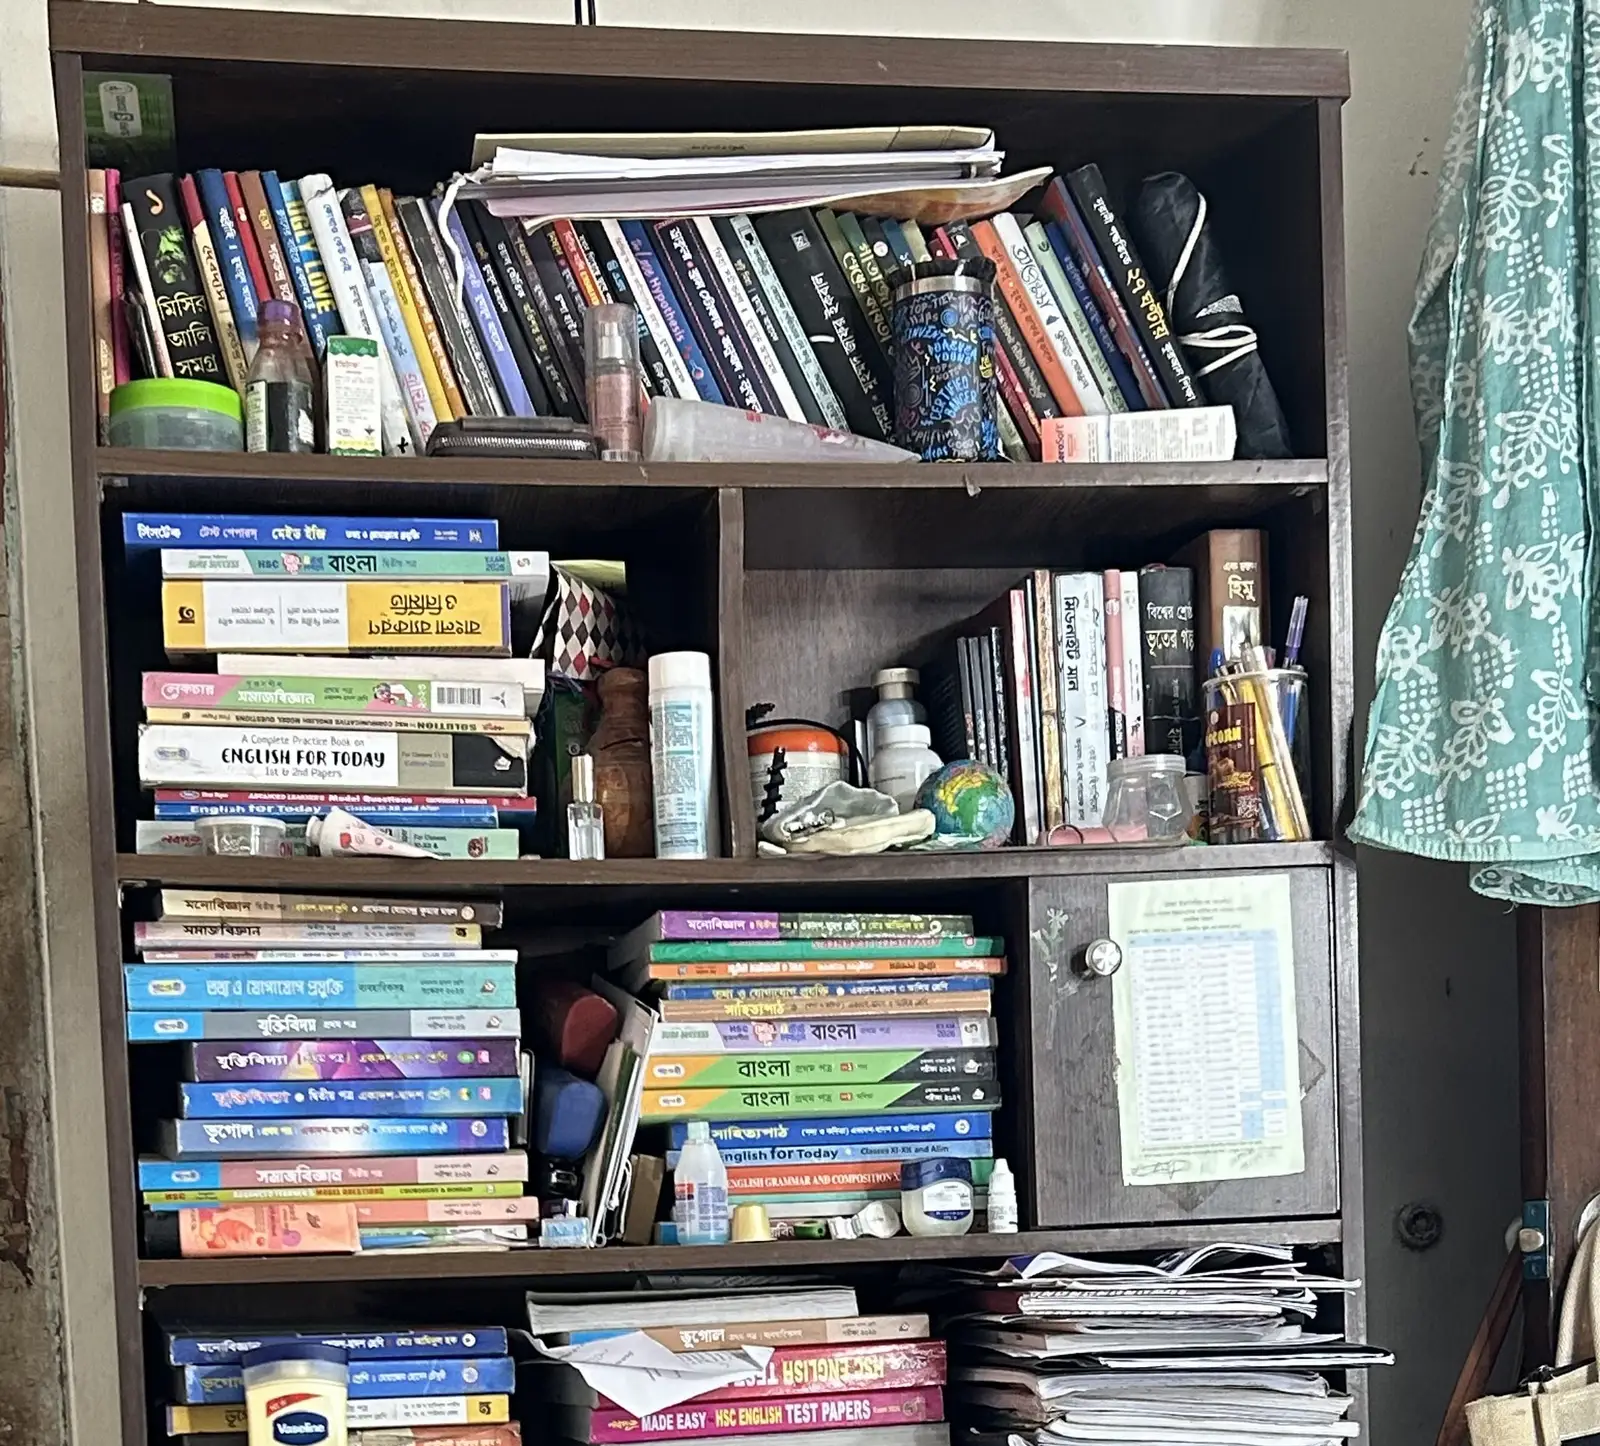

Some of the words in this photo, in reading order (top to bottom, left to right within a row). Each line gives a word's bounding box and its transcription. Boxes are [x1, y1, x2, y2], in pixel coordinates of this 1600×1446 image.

[322, 202, 339, 234] কোথাও
[1089, 196, 1114, 226] নূরানী
[285, 197, 318, 259] UGLY
[303, 258, 334, 314] LOVE
[332, 235, 346, 255] কেউ
[1105, 224, 1133, 266] পদ্ধতিতে
[338, 255, 352, 273] নেই
[666, 225, 694, 263] ড্রাকুলা
[686, 266, 707, 291] ব্রাম
[201, 243, 225, 301] দেবদাস
[838, 250, 870, 295] শেষের
[1005, 239, 1055, 311] অপেক্ষা
[1122, 265, 1149, 294] ২৭
[805, 269, 842, 320] ইকবাল
[156, 291, 208, 321] মিসির
[646, 276, 689, 343] Hypothesis
[1133, 287, 1174, 341] ঘণ্টায়
[166, 322, 213, 349] আলি
[829, 315, 860, 356] জাফর
[175, 353, 219, 377] সমগ্র
[1159, 340, 1187, 378] কুরআন
[847, 351, 880, 394] মুহম্মদ
[930, 375, 969, 421] CERTIFIED
[1176, 373, 1200, 402] শিক্ষা
[944, 390, 977, 418] BANGER
[871, 401, 896, 433] সমগ্র
[272, 525, 302, 541] মেইড
[304, 522, 327, 541] ইজি
[258, 560, 279, 569] HSC
[328, 555, 378, 573] বাংলা
[1227, 574, 1256, 602] হিমু
[389, 595, 442, 615] নির্মিতি
[445, 595, 458, 609] ও
[1147, 602, 1174, 620] বিশ্বের
[368, 619, 433, 635] ব্যাকরণ
[436, 620, 482, 635] বাংলা
[1063, 596, 1080, 660] মিডনাইট
[1145, 629, 1177, 657] ভূতের
[1066, 665, 1080, 692] সান
[161, 683, 215, 700] লেকচার
[238, 688, 315, 705] সমাজবিজ্ঞান
[417, 721, 477, 731] SOLUTION
[241, 735, 249, 743] A
[250, 735, 289, 746] Complete
[292, 736, 328, 745] Practice
[330, 736, 352, 746] Book
[221, 748, 290, 766] ENGLISH
[297, 749, 330, 766] FOR
[331, 750, 386, 768] TODAY
[291, 767, 309, 777] 2nd
[311, 768, 342, 779] Papers
[190, 805, 245, 815] English
[249, 804, 276, 812] for
[278, 805, 321, 814] Today
[184, 897, 251, 913] মনোবিজ্ঞান
[183, 922, 262, 937] সমাজবিজ্ঞান
[687, 917, 745, 931] মনোবিজ্ঞান
[206, 980, 229, 997] তথ্য
[233, 980, 243, 997] ও
[246, 980, 304, 997] যোগাযোগ
[307, 978, 344, 1000] প্রযুক্তি
[724, 1000, 785, 1017] সাহিত্যপাঠ
[256, 1013, 317, 1036] যুক্তিবিদ্যা
[729, 1025, 748, 1033] HSC
[810, 1023, 857, 1041] বাংলা
[215, 1052, 288, 1070] যুক্তিবিদ্যা
[737, 1060, 790, 1078] বাংলা
[818, 1064, 832, 1073] পত্র
[211, 1087, 291, 1109] যুক্তিবিদ্যা
[308, 1086, 335, 1101] দ্বিতীয়
[337, 1089, 354, 1101] পত্র
[741, 1091, 790, 1108] বাংলা
[818, 1094, 833, 1103] পত্র
[202, 1122, 255, 1144] ভূগোল
[711, 1124, 788, 1140] সাহিত্যপাঠ
[770, 1147, 795, 1160] for
[796, 1149, 839, 1162] Today
[861, 1146, 889, 1155] Classes
[914, 1145, 931, 1153] and
[933, 1144, 950, 1152] Alim
[256, 1163, 343, 1184] সমাজবিজ্ঞান
[727, 1176, 767, 1189] ENGLISH
[767, 1174, 812, 1188] GRAMMAR
[812, 1174, 832, 1185] AND
[832, 1172, 891, 1185] COMPOSITION
[679, 1328, 725, 1349] ভূগোল
[782, 1357, 847, 1386] ENGLISH
[853, 1356, 885, 1381] HSC
[641, 1414, 674, 1432] MADE
[676, 1411, 708, 1429] EASY
[715, 1408, 737, 1427] HSC
[739, 1405, 782, 1426] ENGLISH
[785, 1402, 819, 1423] TEST
[822, 1399, 872, 1422] PAPERS
[276, 1422, 325, 1434] Vaseline
